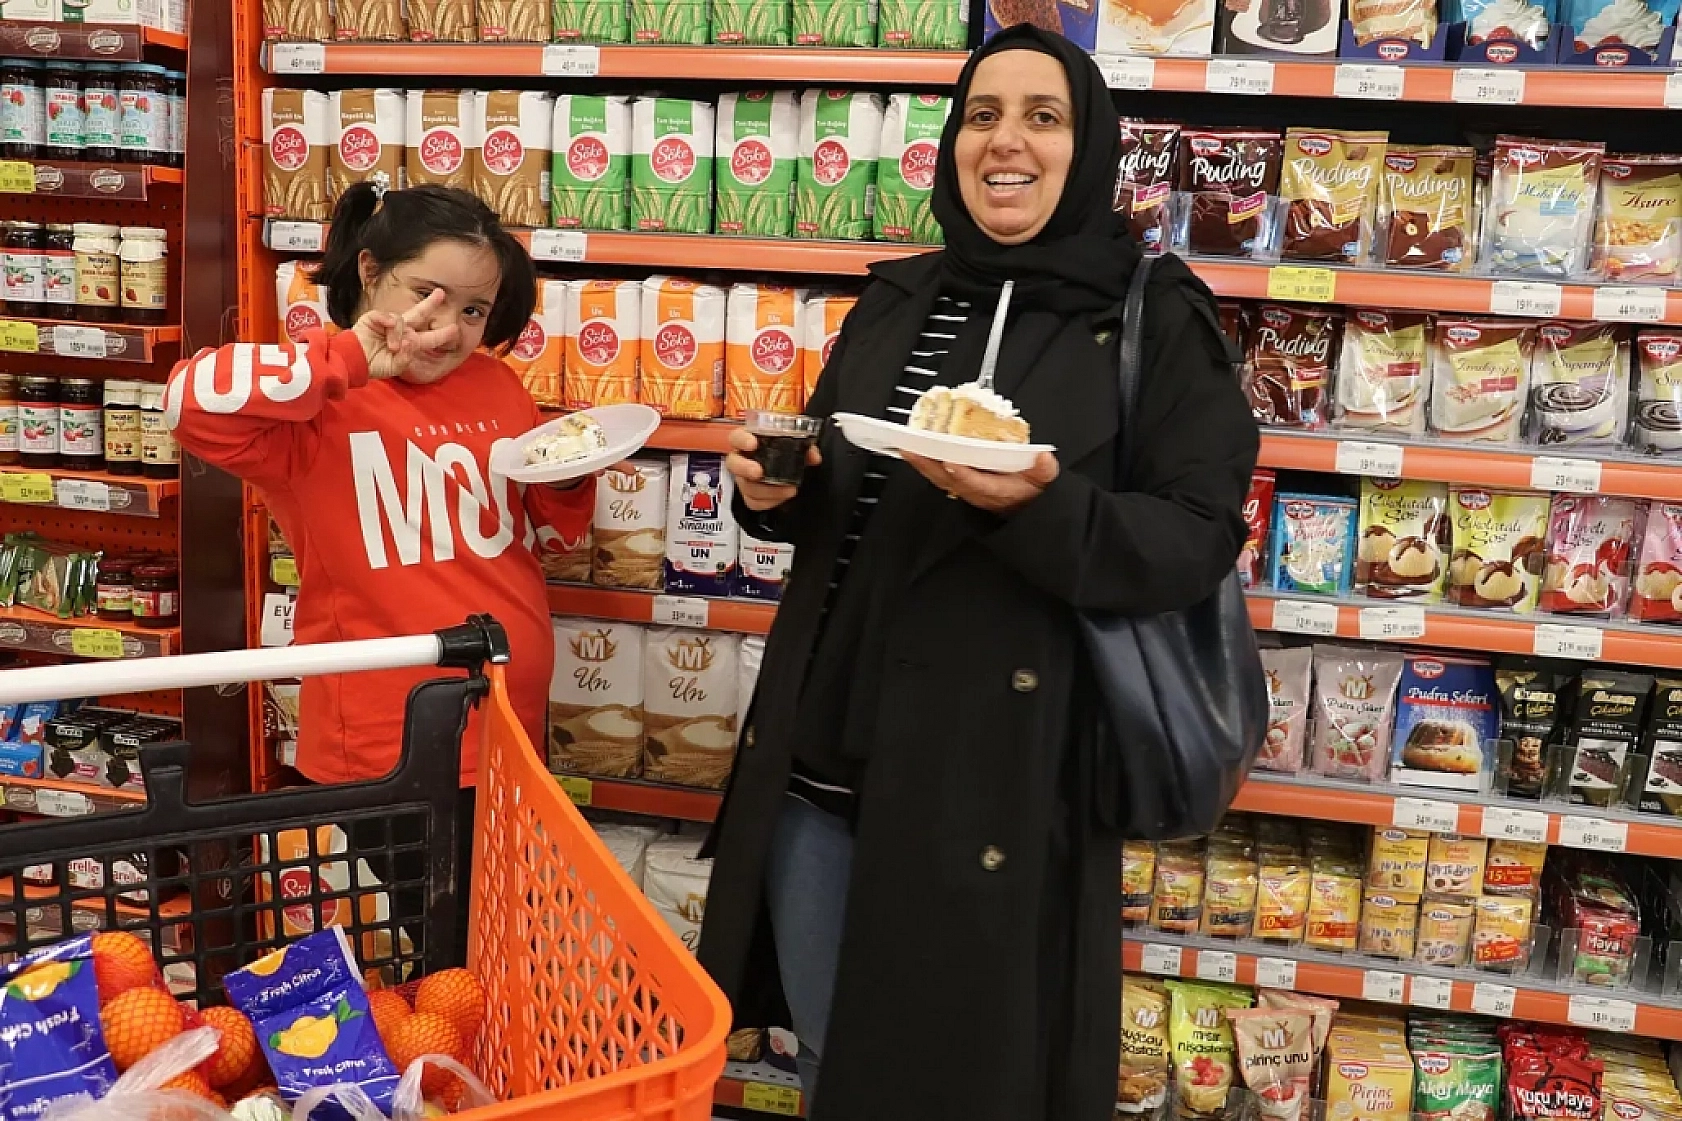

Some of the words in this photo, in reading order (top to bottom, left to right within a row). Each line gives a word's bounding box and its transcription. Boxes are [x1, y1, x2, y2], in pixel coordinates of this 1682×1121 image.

[572, 142, 603, 163] Söke
[657, 144, 689, 164] Söke
[735, 146, 767, 167] Söke
[817, 147, 844, 166] Söke
[1190, 155, 1266, 188] Puding
[1293, 158, 1372, 189] Puding
[583, 328, 613, 347] Söke
[659, 331, 690, 350] Söke
[756, 336, 789, 355] Söke
[1257, 327, 1328, 363] Puding
[610, 500, 641, 521] Un
[690, 548, 709, 559] UN
[756, 554, 775, 566] UN
[573, 666, 611, 692] Un
[669, 676, 707, 703] Un
[1408, 686, 1448, 702] Pudra
[1451, 688, 1488, 705] Şekeri
[1586, 936, 1620, 952] Maya
[1284, 1052, 1308, 1065] unu
[1555, 1088, 1593, 1109] Maya
